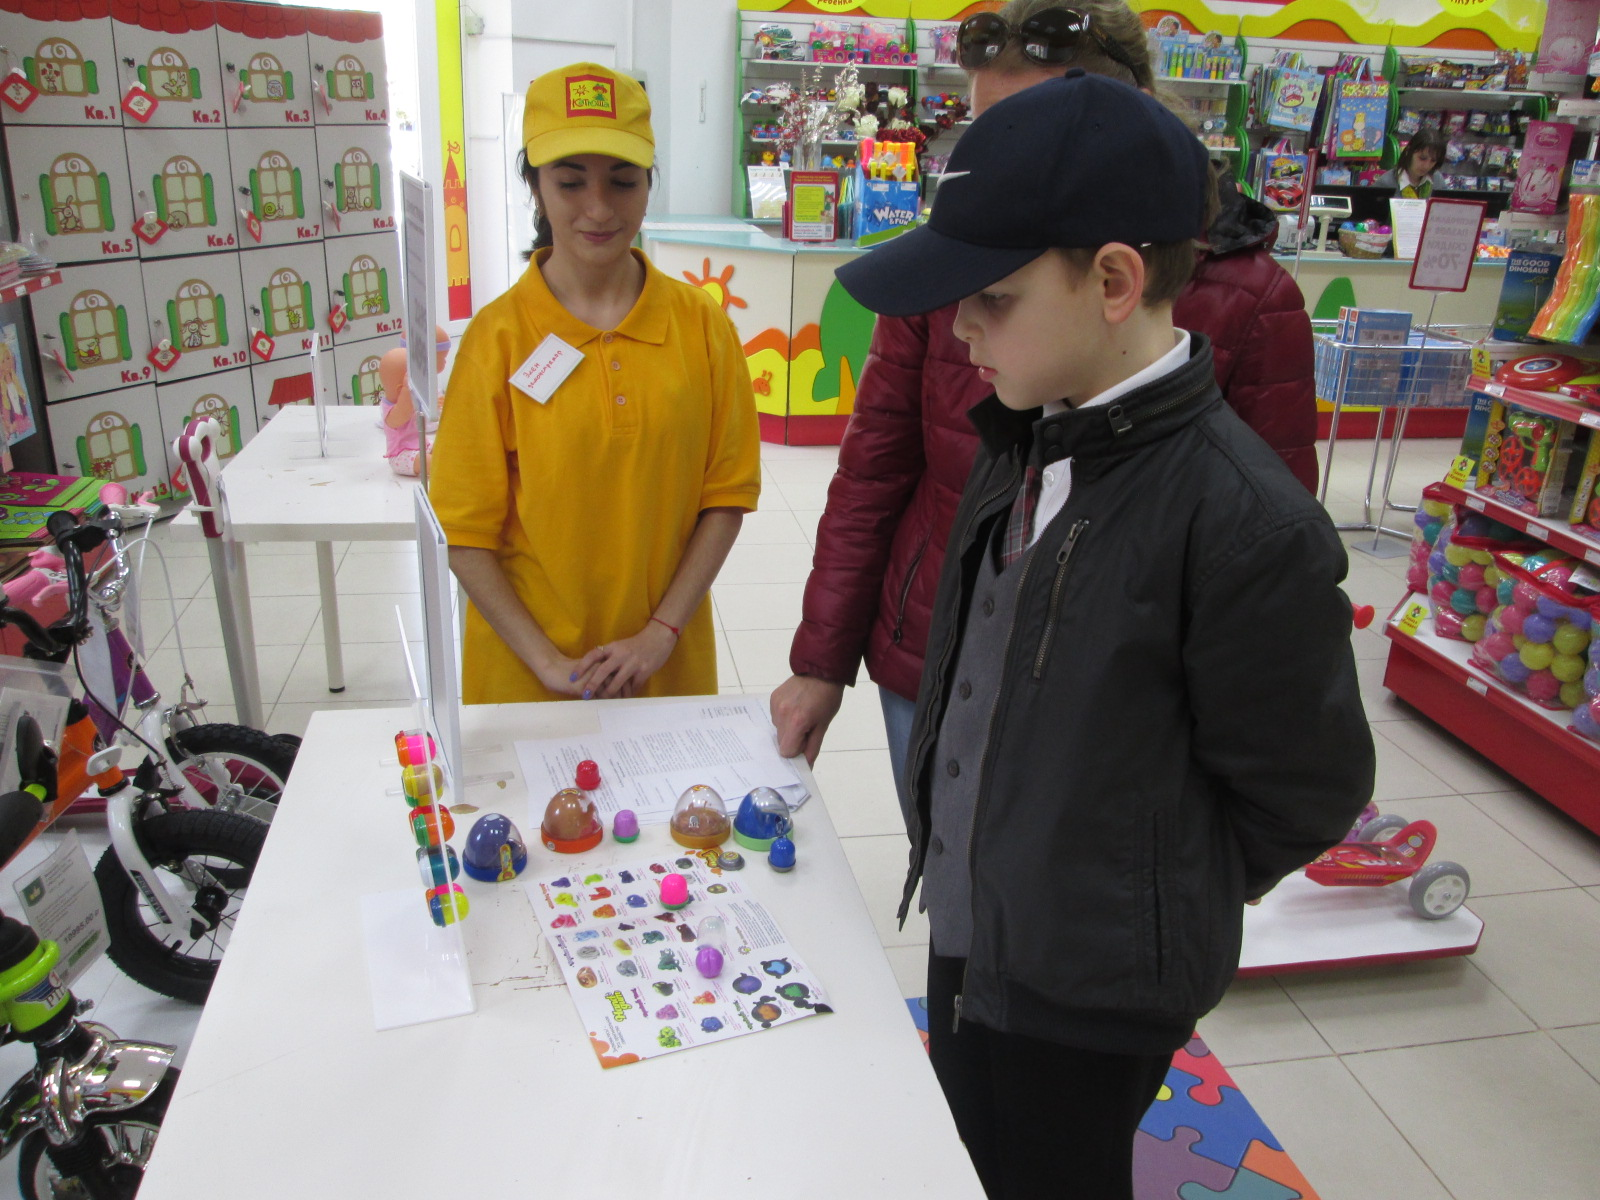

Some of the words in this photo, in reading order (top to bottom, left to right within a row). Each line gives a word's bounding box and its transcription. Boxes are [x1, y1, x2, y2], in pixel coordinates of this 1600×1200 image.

[84, 105, 117, 120] Кв.1
[193, 109, 221, 123] Кв.2
[285, 110, 311, 123] Кв.3
[365, 109, 388, 122] Кв.4
[873, 206, 915, 222] WATER
[373, 216, 395, 229] Кв.8
[297, 224, 321, 239] Кв.7
[102, 239, 134, 254] Кв.5
[207, 233, 235, 247] Кв.6
[1508, 265, 1549, 274] DINOSAUR
[1522, 260, 1550, 268] GOOD
[376, 319, 402, 333] Кв.12
[213, 351, 247, 368] Кв.10
[121, 368, 151, 383] Кв.9
[612, 990, 632, 1010] gum
[605, 993, 627, 1022] Hand
